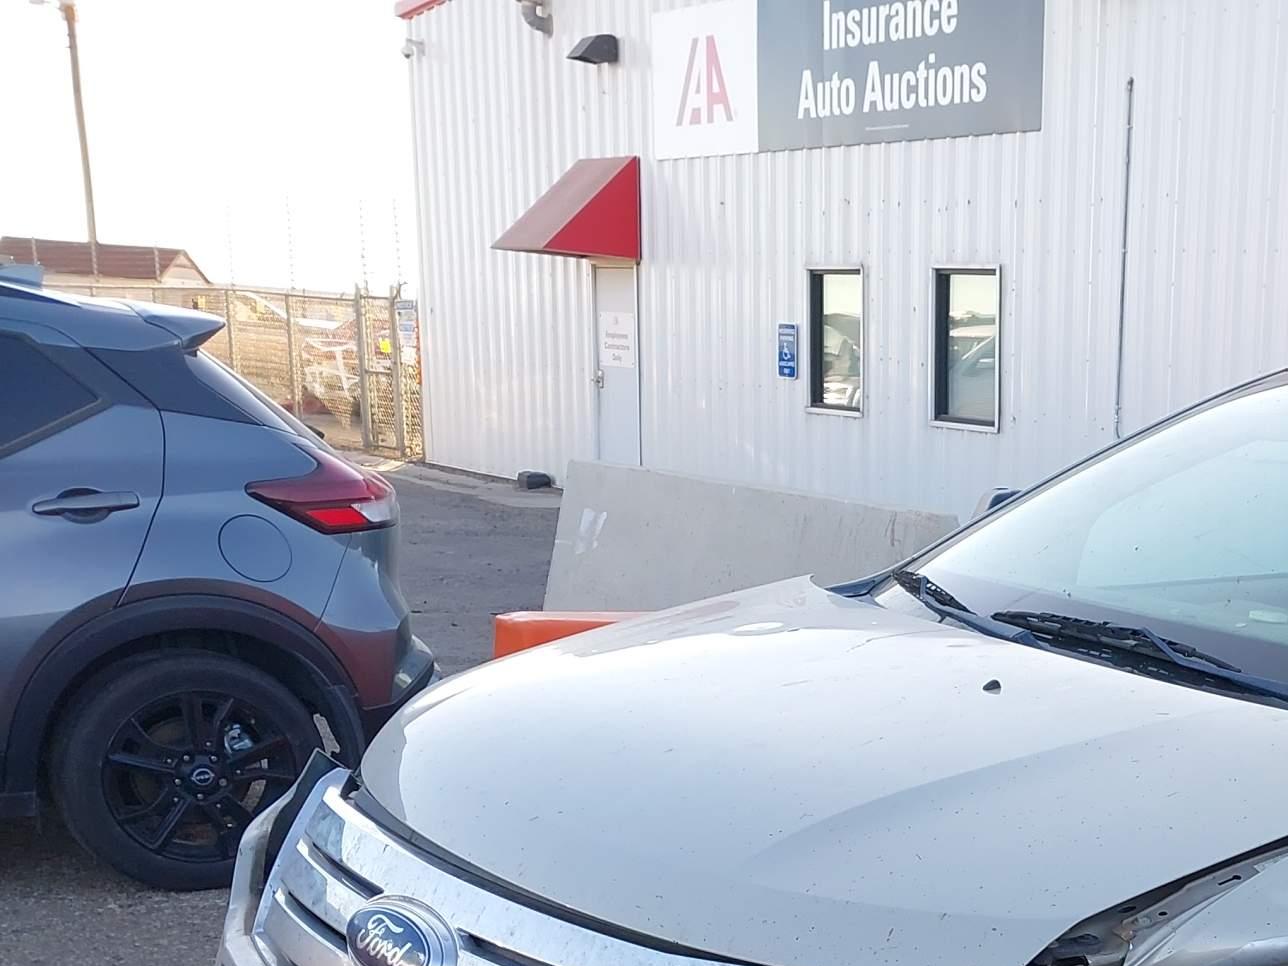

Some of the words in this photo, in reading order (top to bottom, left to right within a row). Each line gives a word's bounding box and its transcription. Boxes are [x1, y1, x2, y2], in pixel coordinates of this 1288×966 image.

[822, 0, 959, 51] Insurance
[797, 69, 856, 119] Auto
[862, 52, 988, 113] Auctions
